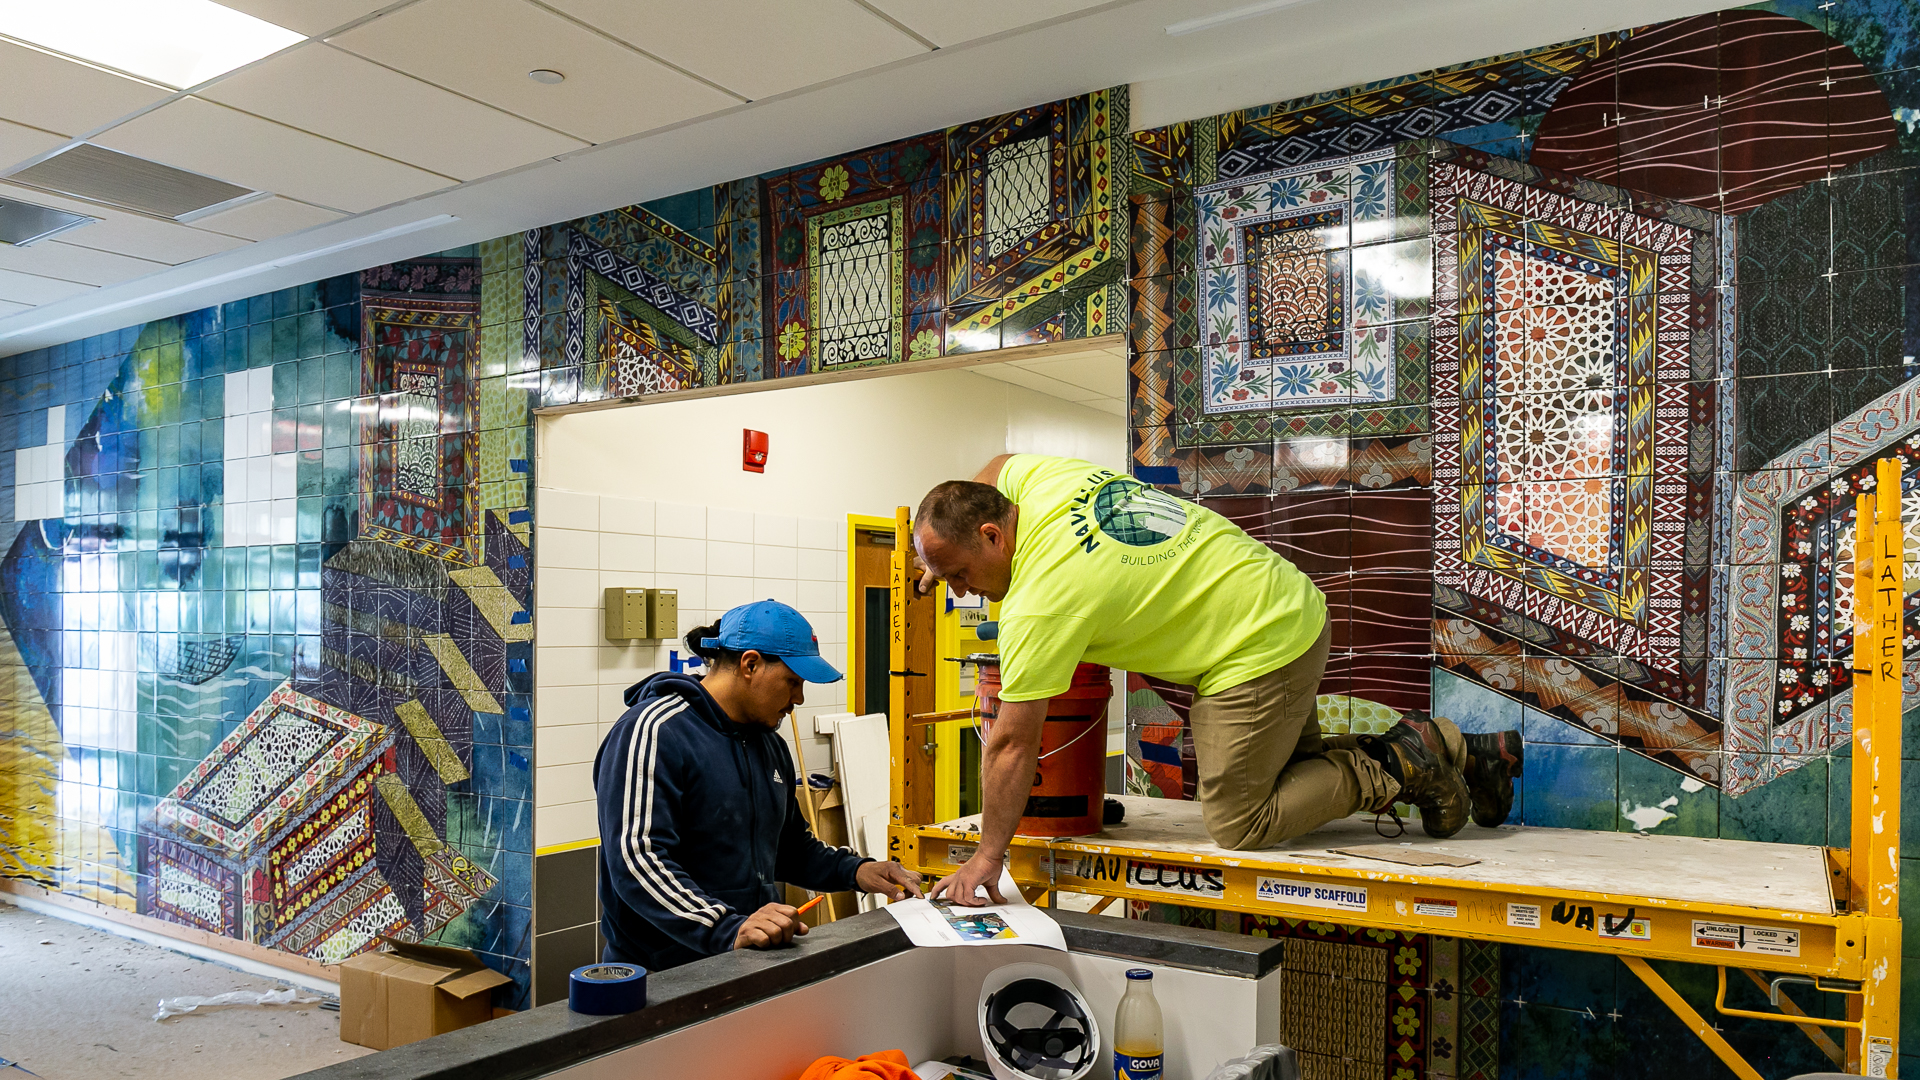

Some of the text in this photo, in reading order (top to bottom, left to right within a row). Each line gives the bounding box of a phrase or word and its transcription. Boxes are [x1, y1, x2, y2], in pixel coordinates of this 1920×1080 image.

[1120, 548, 1177, 566] BUILDING
[1177, 533, 1197, 552] THE
[892, 560, 902, 644] LATHER
[1877, 534, 1899, 682] LATHER
[1273, 883, 1366, 904] STEPUP SCAFFOLD
[1706, 925, 1739, 934] UNLOCKED
[1753, 930, 1778, 938] LOCKED
[1706, 940, 1733, 948] WARNING
[1131, 1058, 1160, 1069] GOYA
